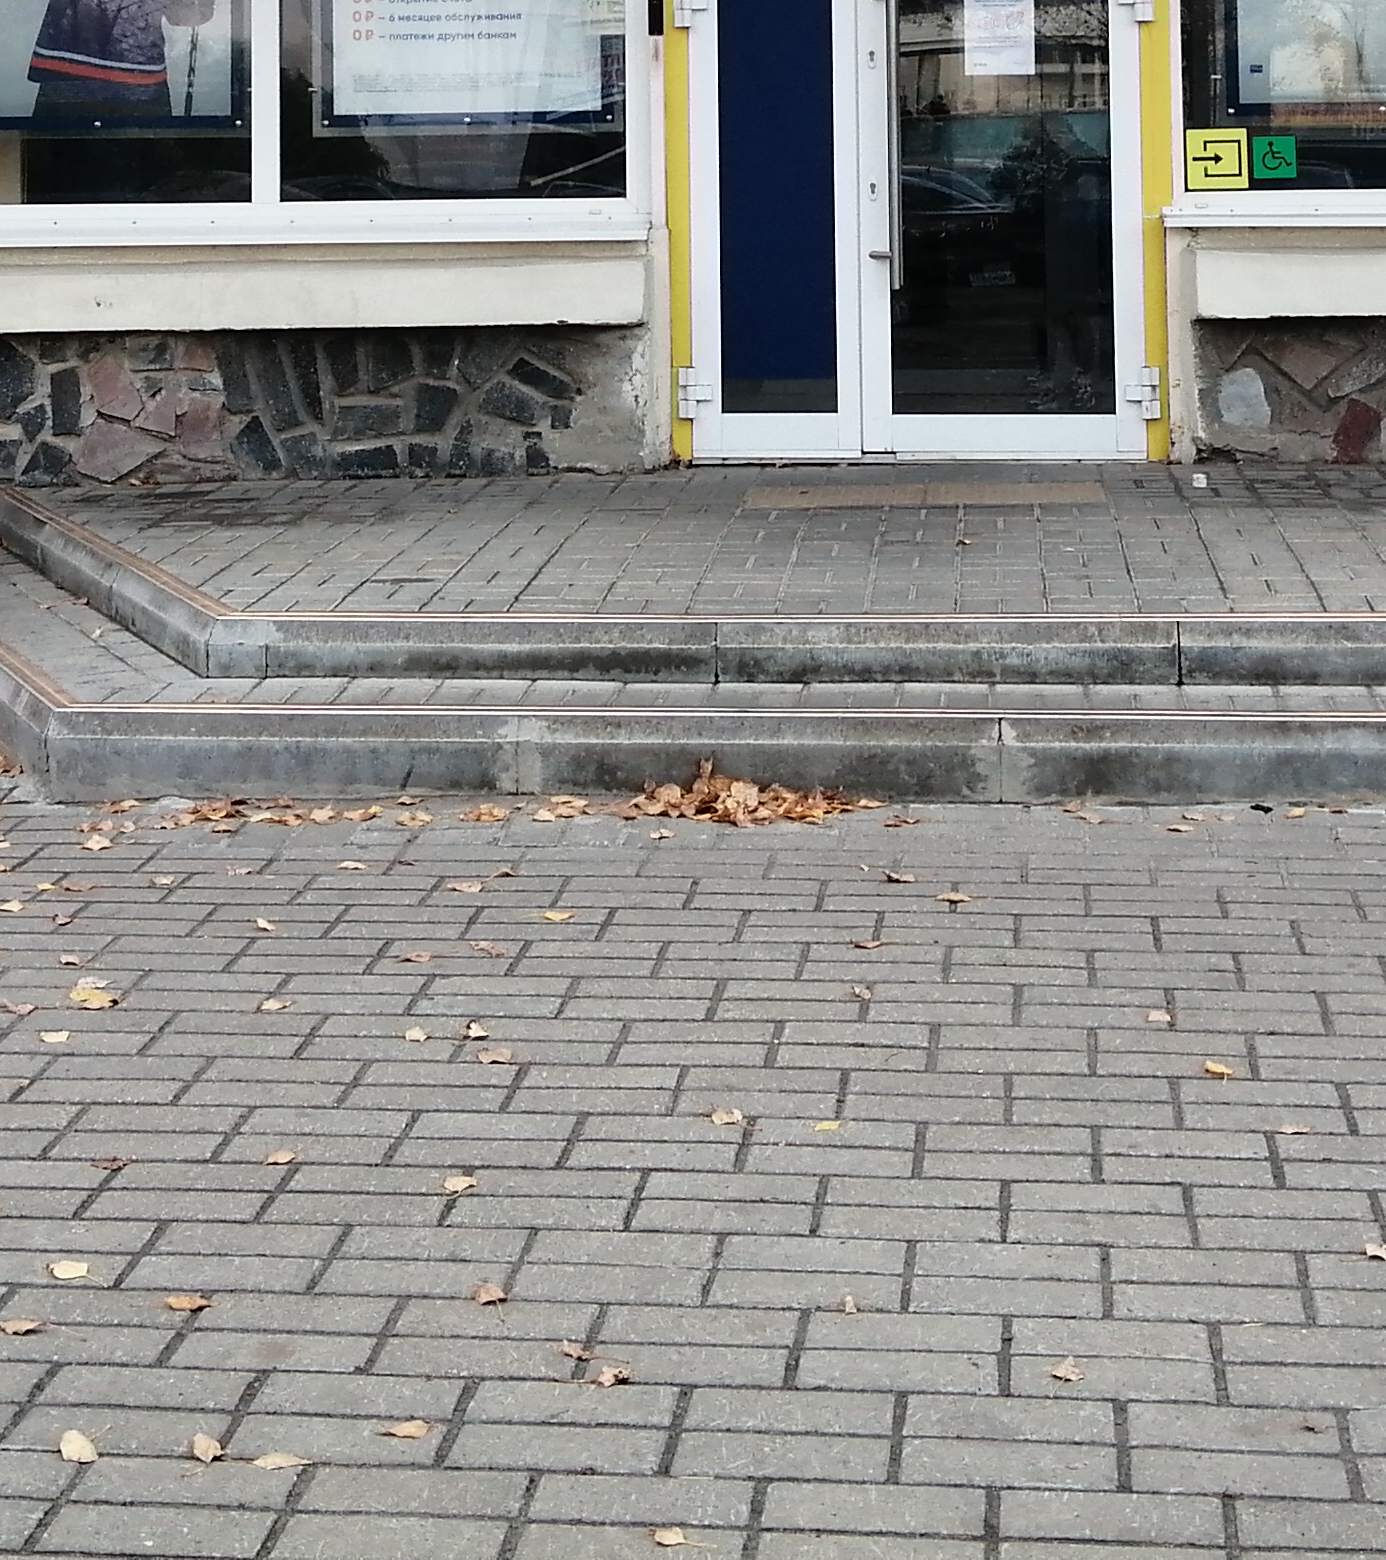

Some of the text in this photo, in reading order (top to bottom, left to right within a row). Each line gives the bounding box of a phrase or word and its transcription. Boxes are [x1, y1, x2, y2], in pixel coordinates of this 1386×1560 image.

[352, 10, 362, 22] 0
[398, 13, 442, 23] месяцев
[444, 11, 522, 23] обслуживания
[352, 30, 362, 42] 0
[389, 31, 435, 41] платежи
[436, 31, 475, 42] другим
[477, 30, 517, 41] банкам
